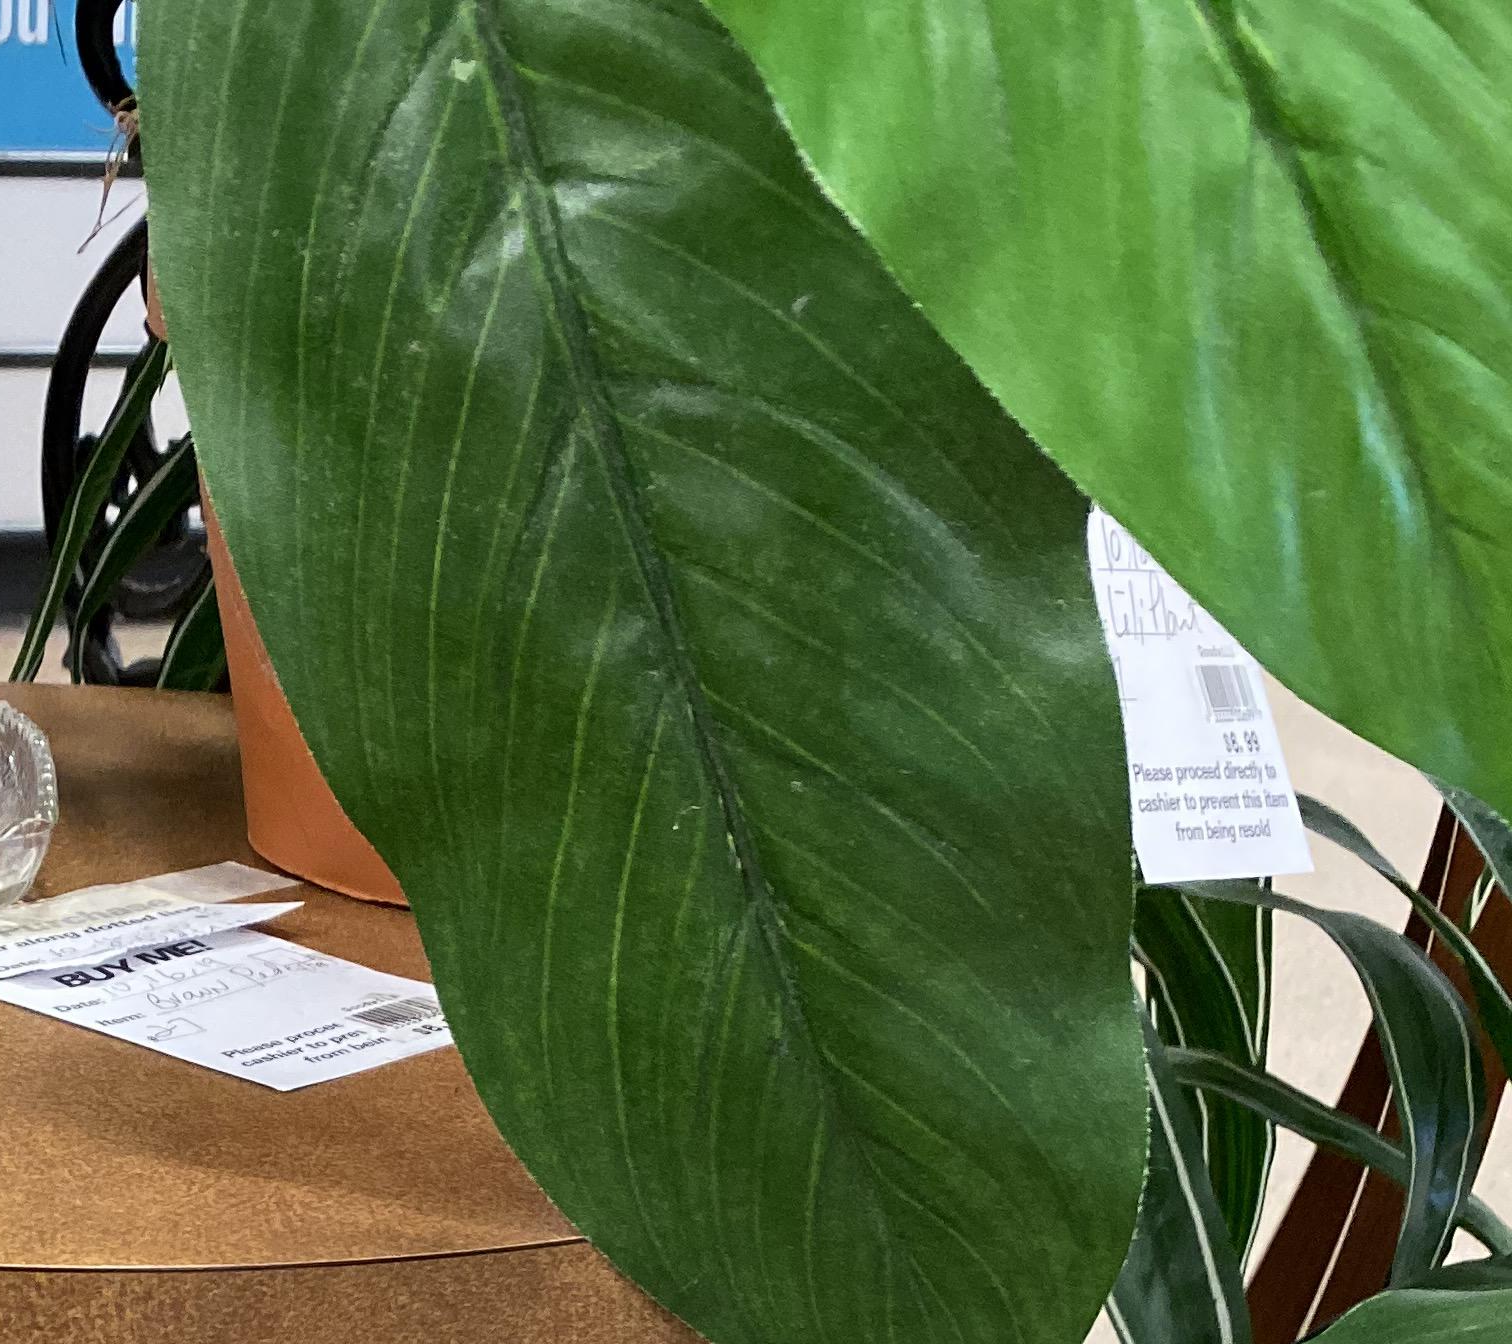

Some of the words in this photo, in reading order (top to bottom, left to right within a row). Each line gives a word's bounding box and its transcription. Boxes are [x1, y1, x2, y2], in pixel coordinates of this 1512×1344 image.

[1133, 763, 1174, 783] Please
[1175, 761, 1221, 785] proceed
[1224, 760, 1263, 783] directly
[1265, 763, 1278, 780] to
[1138, 792, 1180, 813] cashier
[1183, 792, 1197, 810] to
[1199, 792, 1241, 815] prevent
[1242, 790, 1263, 809] this
[1264, 789, 1289, 808] item
[1175, 821, 1204, 841] from
[1205, 820, 1238, 844] being
[1239, 818, 1272, 839] resold
[14, 930, 81, 949] along
[84, 913, 158, 935] dotted
[50, 958, 136, 988] BUY
[134, 939, 215, 965] ME!
[53, 997, 106, 1012] Date:
[95, 1013, 148, 1027] Item:
[221, 1039, 284, 1058] Please
[241, 1046, 304, 1067] cashier
[305, 1039, 328, 1050] to
[303, 1049, 350, 1065] from
[350, 1035, 393, 1051] bein
